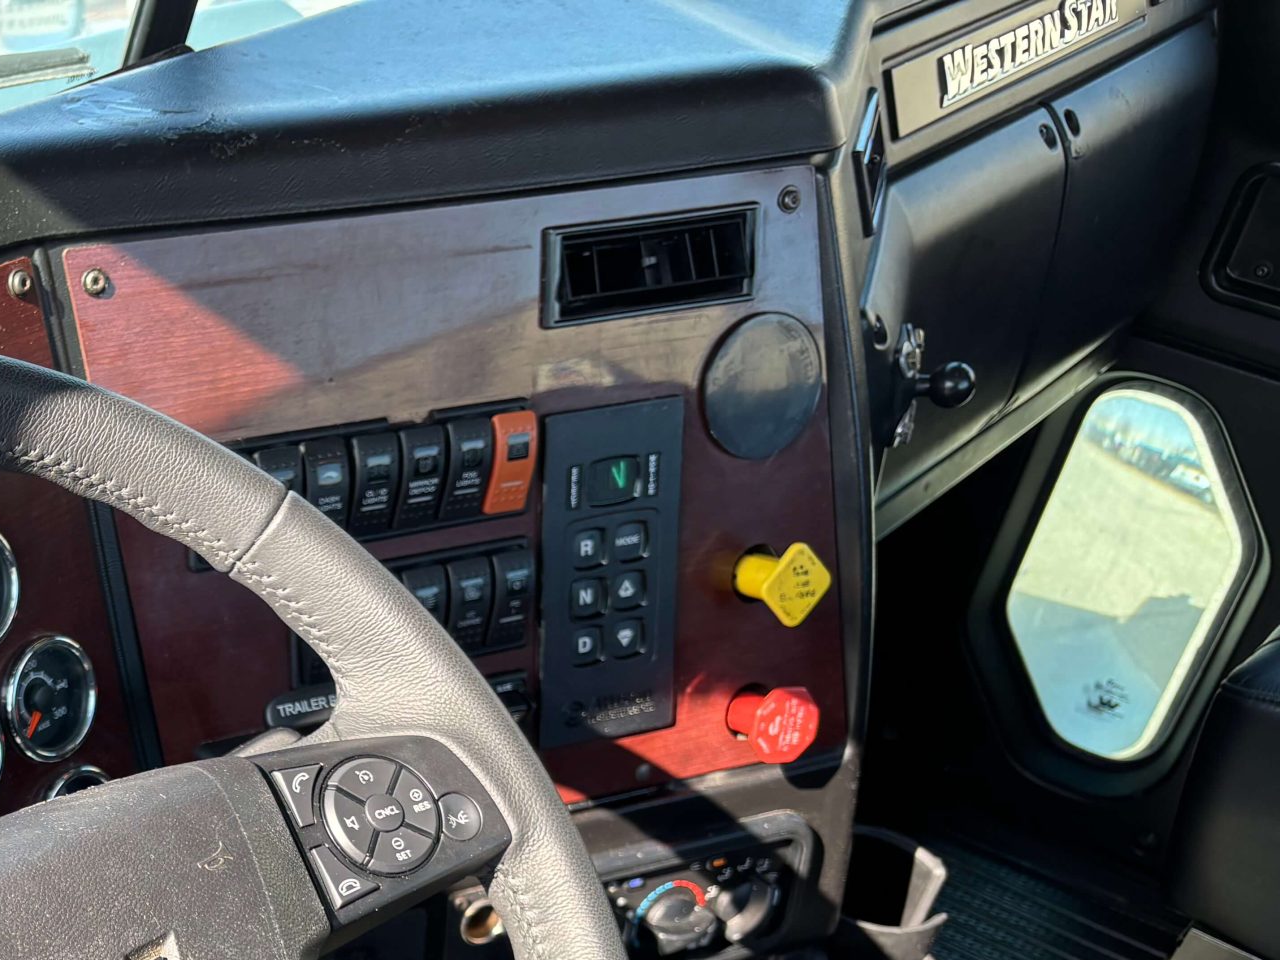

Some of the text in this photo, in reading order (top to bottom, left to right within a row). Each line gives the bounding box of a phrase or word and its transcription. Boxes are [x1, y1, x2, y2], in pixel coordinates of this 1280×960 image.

[580, 539, 594, 557] R
[579, 589, 592, 605] N
[578, 637, 592, 653] D
[276, 696, 329, 718] TRAILER
[374, 806, 400, 819] CNCL
[413, 802, 432, 813] RES
[395, 849, 412, 861] SET
